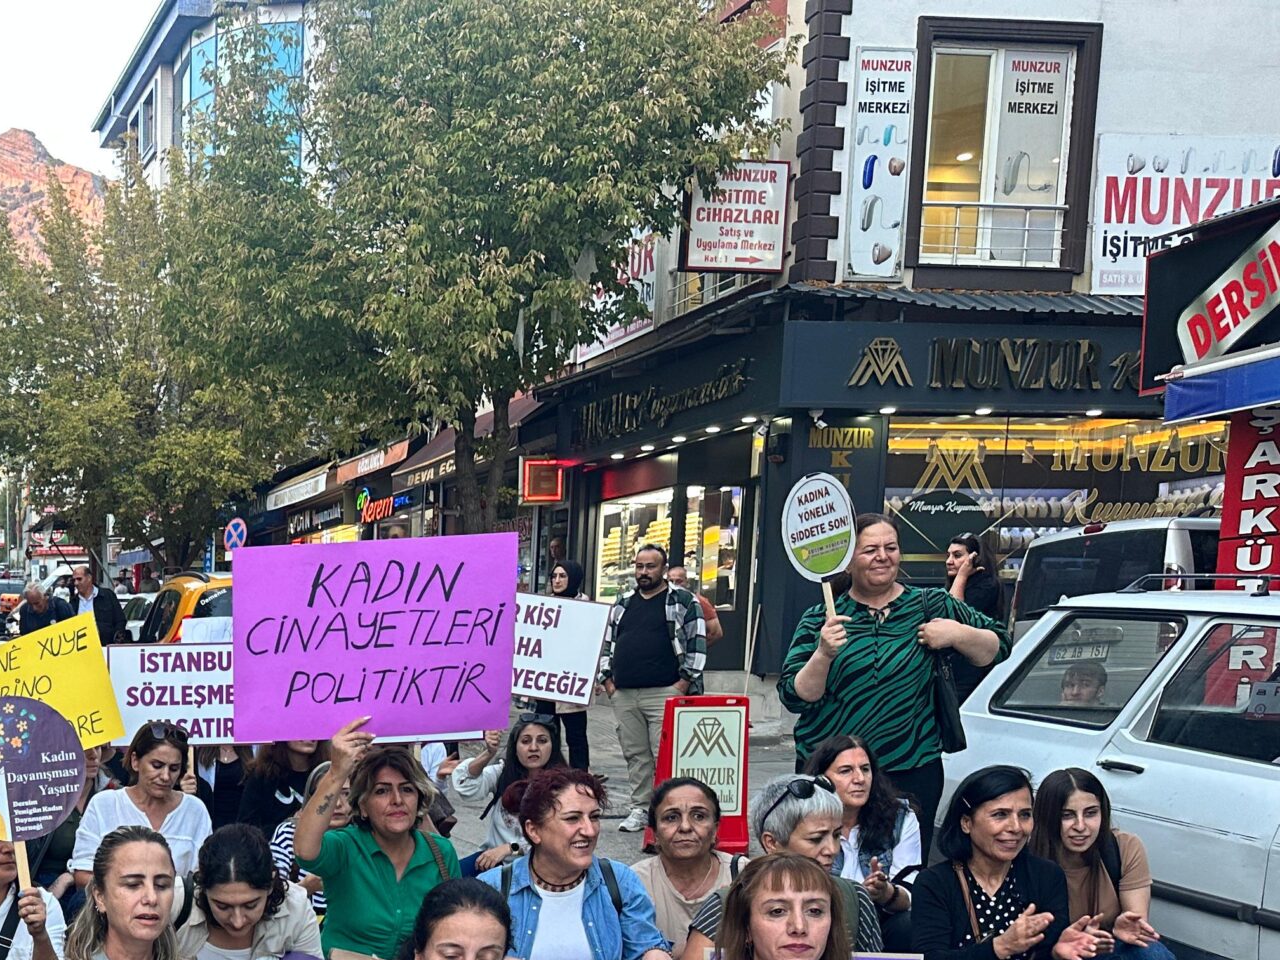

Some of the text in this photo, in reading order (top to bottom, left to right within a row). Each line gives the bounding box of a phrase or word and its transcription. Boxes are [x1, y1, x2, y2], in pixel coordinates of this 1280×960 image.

[861, 59, 912, 72] MUNZUR
[1012, 60, 1061, 73] MUNZUR
[865, 78, 905, 95] İŞİTME
[1015, 78, 1054, 96] İŞİTME
[858, 100, 910, 114] MERKEZİ
[1007, 100, 1058, 115] MERKEZİ
[696, 207, 779, 224] CİHAZLARI
[719, 226, 740, 239] Satış
[696, 238, 775, 251] Uygulama Merkezi
[929, 337, 1101, 390] MUNZUR
[808, 428, 874, 449] MUNZUR
[407, 467, 434, 487] DEVA
[797, 486, 830, 506] KADINA
[798, 500, 836, 523] YÖNELİK
[909, 501, 943, 514] Munzur
[828, 515, 849, 532] SON!
[307, 559, 464, 608] KADIN
[524, 603, 562, 630] KİŞİ
[246, 602, 506, 655] CİNAYETLERİ
[140, 649, 232, 673] İSTANBU
[285, 661, 491, 707] POLİTİKTİR
[513, 668, 589, 697] YECEĞİZ
[126, 682, 234, 709] SÖZLEŞME
[41, 750, 76, 764] Kadın
[7, 767, 78, 785] Dayanışması
[39, 782, 80, 797] Yaşatır
